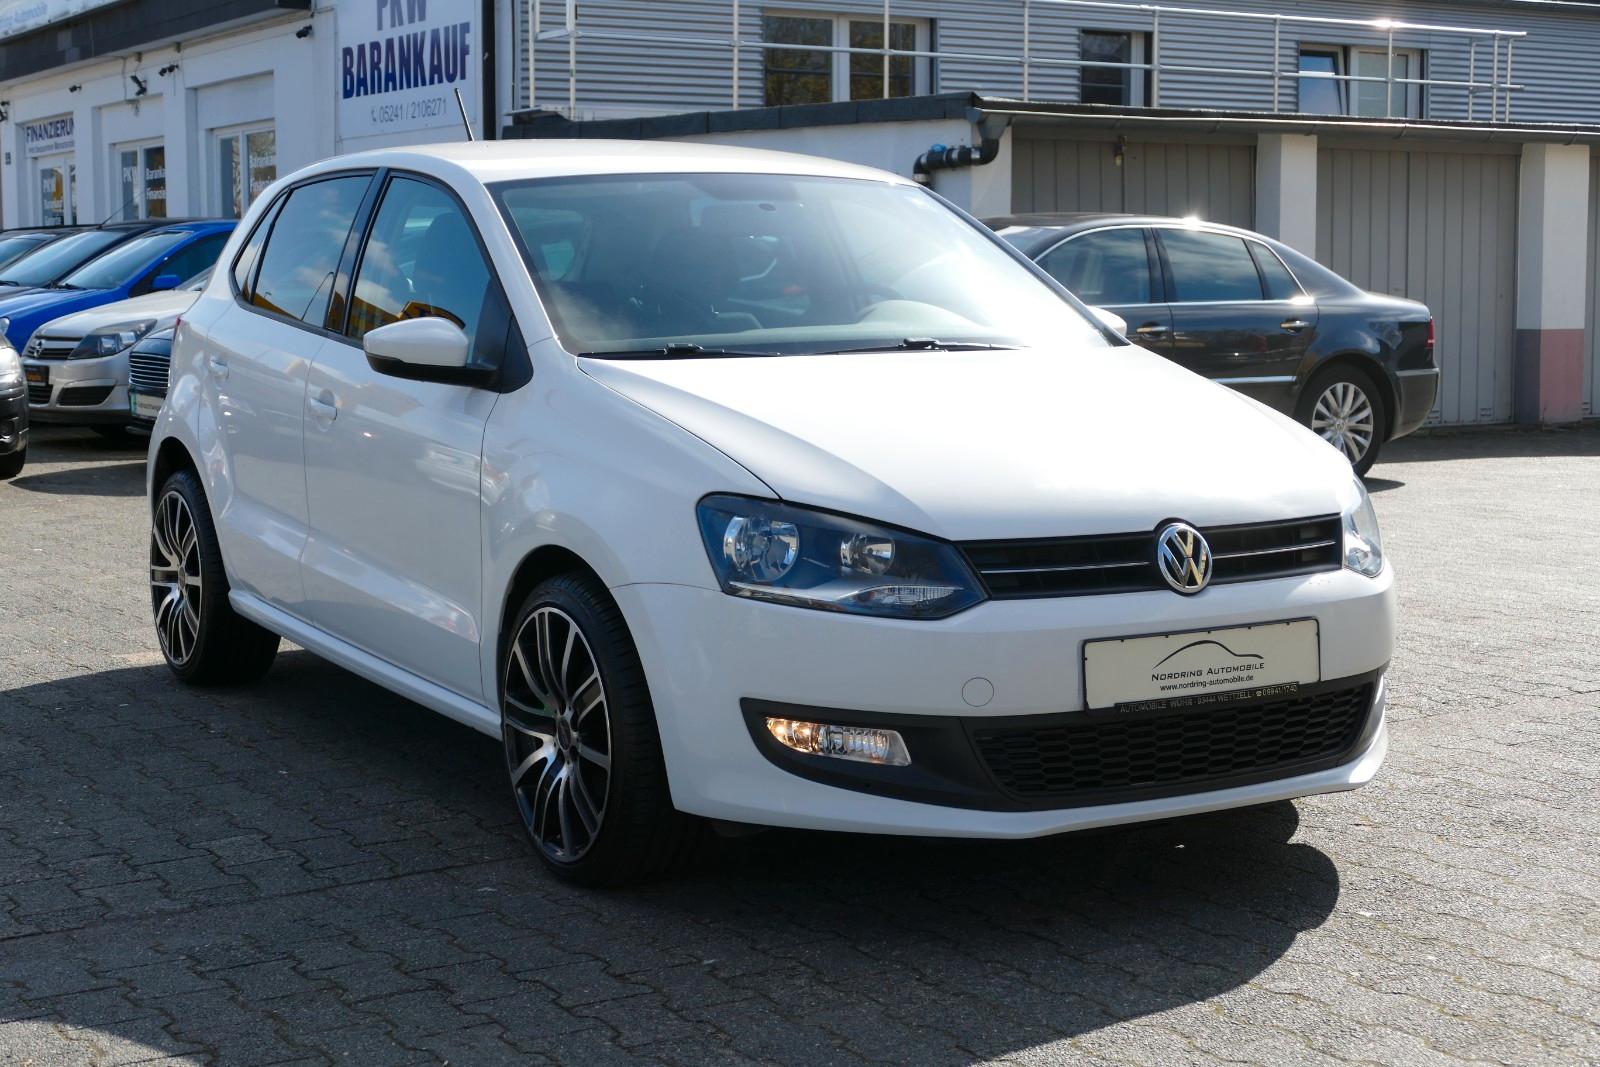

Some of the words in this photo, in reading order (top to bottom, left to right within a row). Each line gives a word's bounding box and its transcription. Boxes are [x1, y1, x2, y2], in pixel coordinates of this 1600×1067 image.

[342, 22, 470, 99] BARANKAUF
[1151, 669, 1203, 682] NORDRING
[1206, 662, 1265, 676] AUTOMOBILE
[1160, 674, 1254, 691] www.nordring-automobile.de
